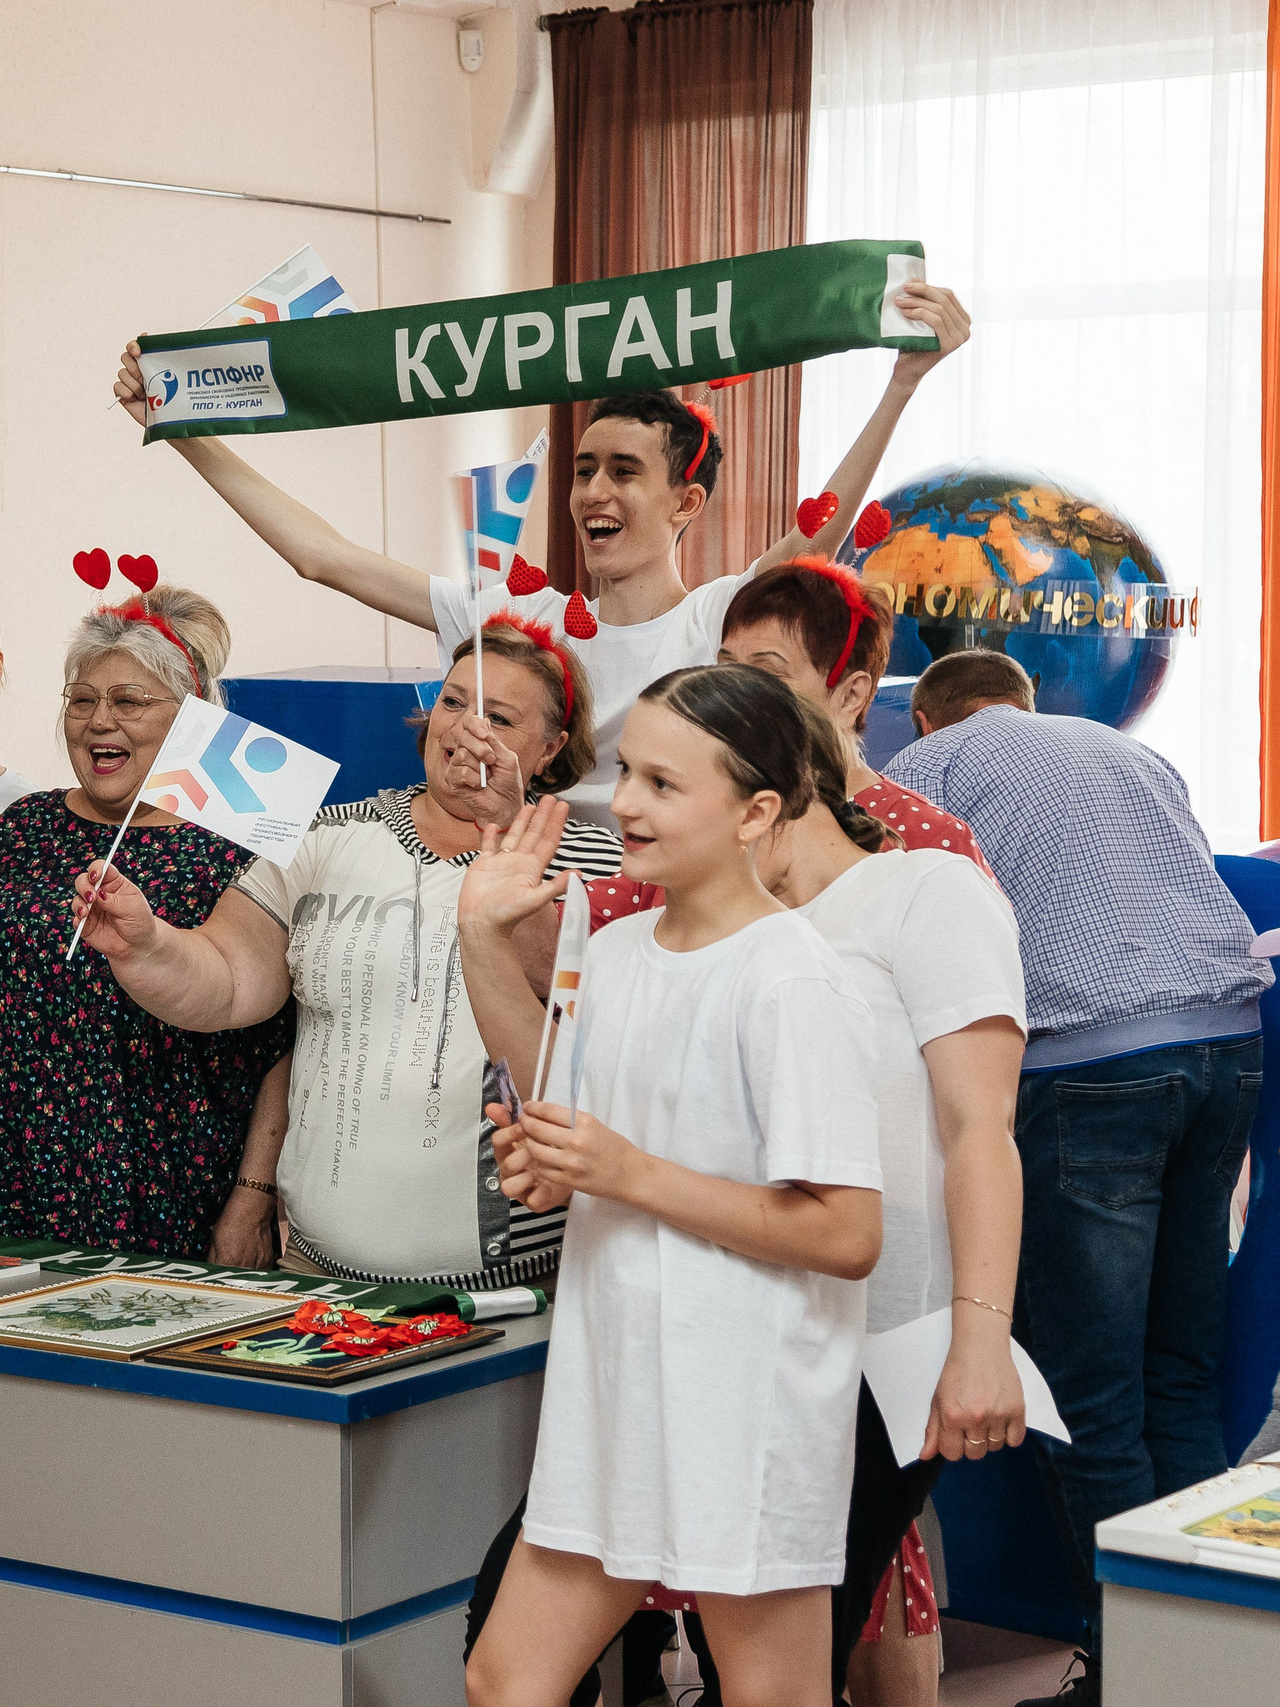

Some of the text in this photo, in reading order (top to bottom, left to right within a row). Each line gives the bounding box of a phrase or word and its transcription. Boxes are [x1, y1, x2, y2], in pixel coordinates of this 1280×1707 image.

[394, 280, 736, 403] КУРГАН
[187, 364, 265, 388] ПСПФНР
[192, 402, 213, 410] ППО
[225, 398, 263, 409] КУРГАН
[329, 920, 341, 934] SO
[320, 935, 334, 970] DON'T
[341, 935, 359, 967] YOUR
[364, 949, 377, 961] IS
[311, 968, 321, 1003] WHAT
[318, 973, 330, 1008] MAKE
[340, 969, 351, 1001] BEST
[360, 963, 374, 1029] PERSONAL
[393, 981, 408, 1021] KNOW
[341, 1003, 351, 1019] TO
[388, 1023, 403, 1058] YOUR
[338, 1058, 349, 1081] THE
[380, 1060, 395, 1101] LIMITS
[321, 1078, 330, 1101] ALL
[335, 1083, 347, 1136] PERFECT
[351, 1098, 362, 1115] OF
[349, 1117, 360, 1150] TRUE
[331, 1139, 343, 1188] CHANCE
